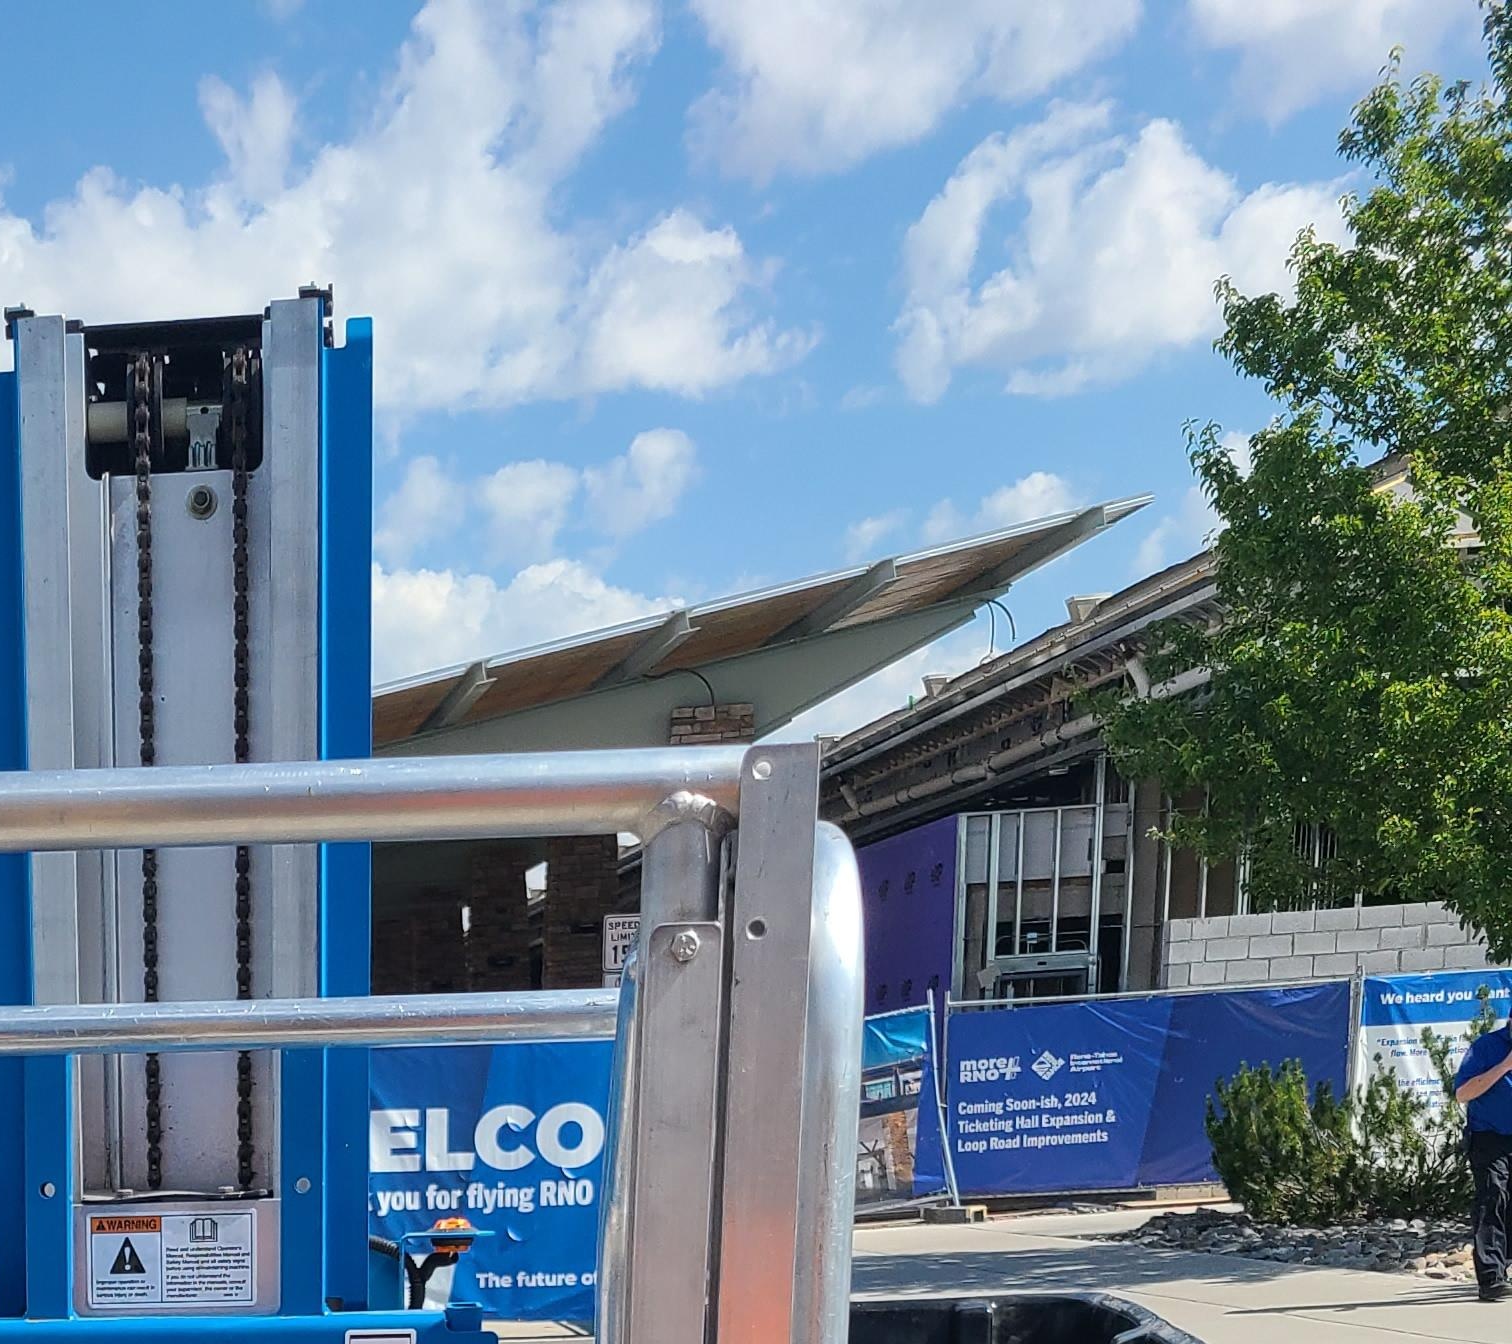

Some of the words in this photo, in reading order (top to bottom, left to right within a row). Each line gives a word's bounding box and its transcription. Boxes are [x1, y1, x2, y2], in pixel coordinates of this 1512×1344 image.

[608, 920, 641, 931] SPEED
[1380, 993, 1403, 1005] We
[1405, 989, 1445, 1004] heard
[1446, 990, 1473, 1005] you
[1475, 986, 1510, 1000] ant
[958, 1100, 1004, 1116] Coming
[1005, 1095, 1062, 1113] Soon-ish,
[1064, 1091, 1097, 1107] 2024
[957, 1118, 1014, 1134] Ticketing
[1015, 1115, 1039, 1130] Hall
[1041, 1110, 1104, 1130] Expansion
[1105, 1109, 1116, 1123] &
[957, 1139, 988, 1154] Loop
[989, 1134, 1020, 1150] Road
[1022, 1128, 1109, 1149] Improvements
[376, 1190, 421, 1217] you
[425, 1184, 464, 1211] for
[466, 1180, 536, 1215] flying
[539, 1179, 594, 1207] RNO
[106, 1219, 157, 1232] WARNING
[475, 1271, 513, 1289] The
[516, 1269, 579, 1288] future
